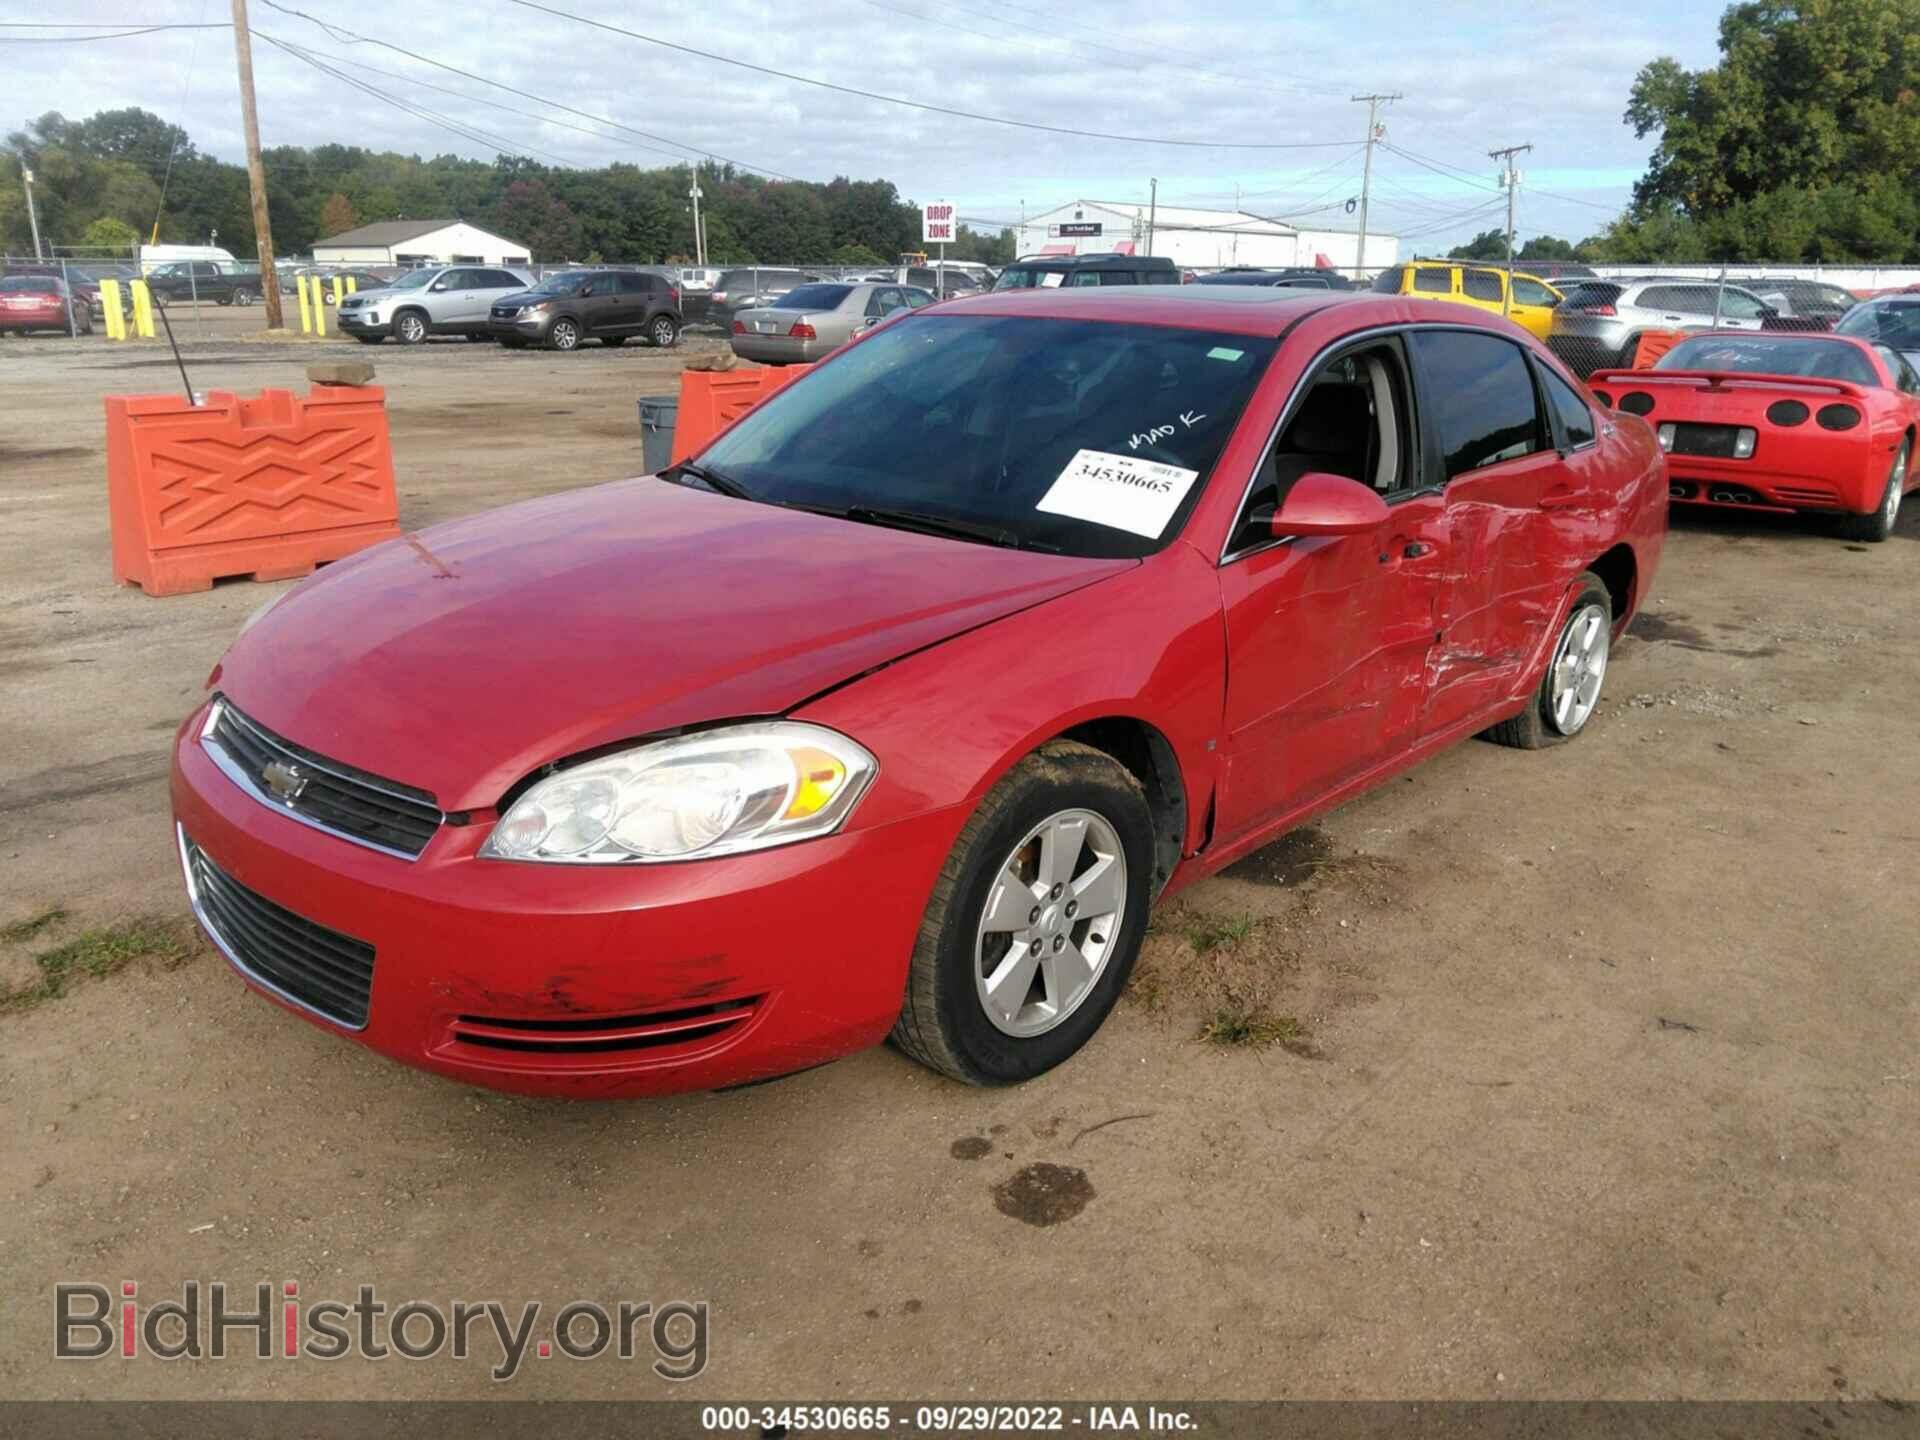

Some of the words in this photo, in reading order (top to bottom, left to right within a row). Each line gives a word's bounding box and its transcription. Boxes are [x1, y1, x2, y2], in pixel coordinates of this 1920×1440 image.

[927, 206, 952, 220] DROP
[928, 224, 951, 238] ZONE
[1179, 410, 1208, 429] K
[1075, 464, 1173, 493] 34530665
